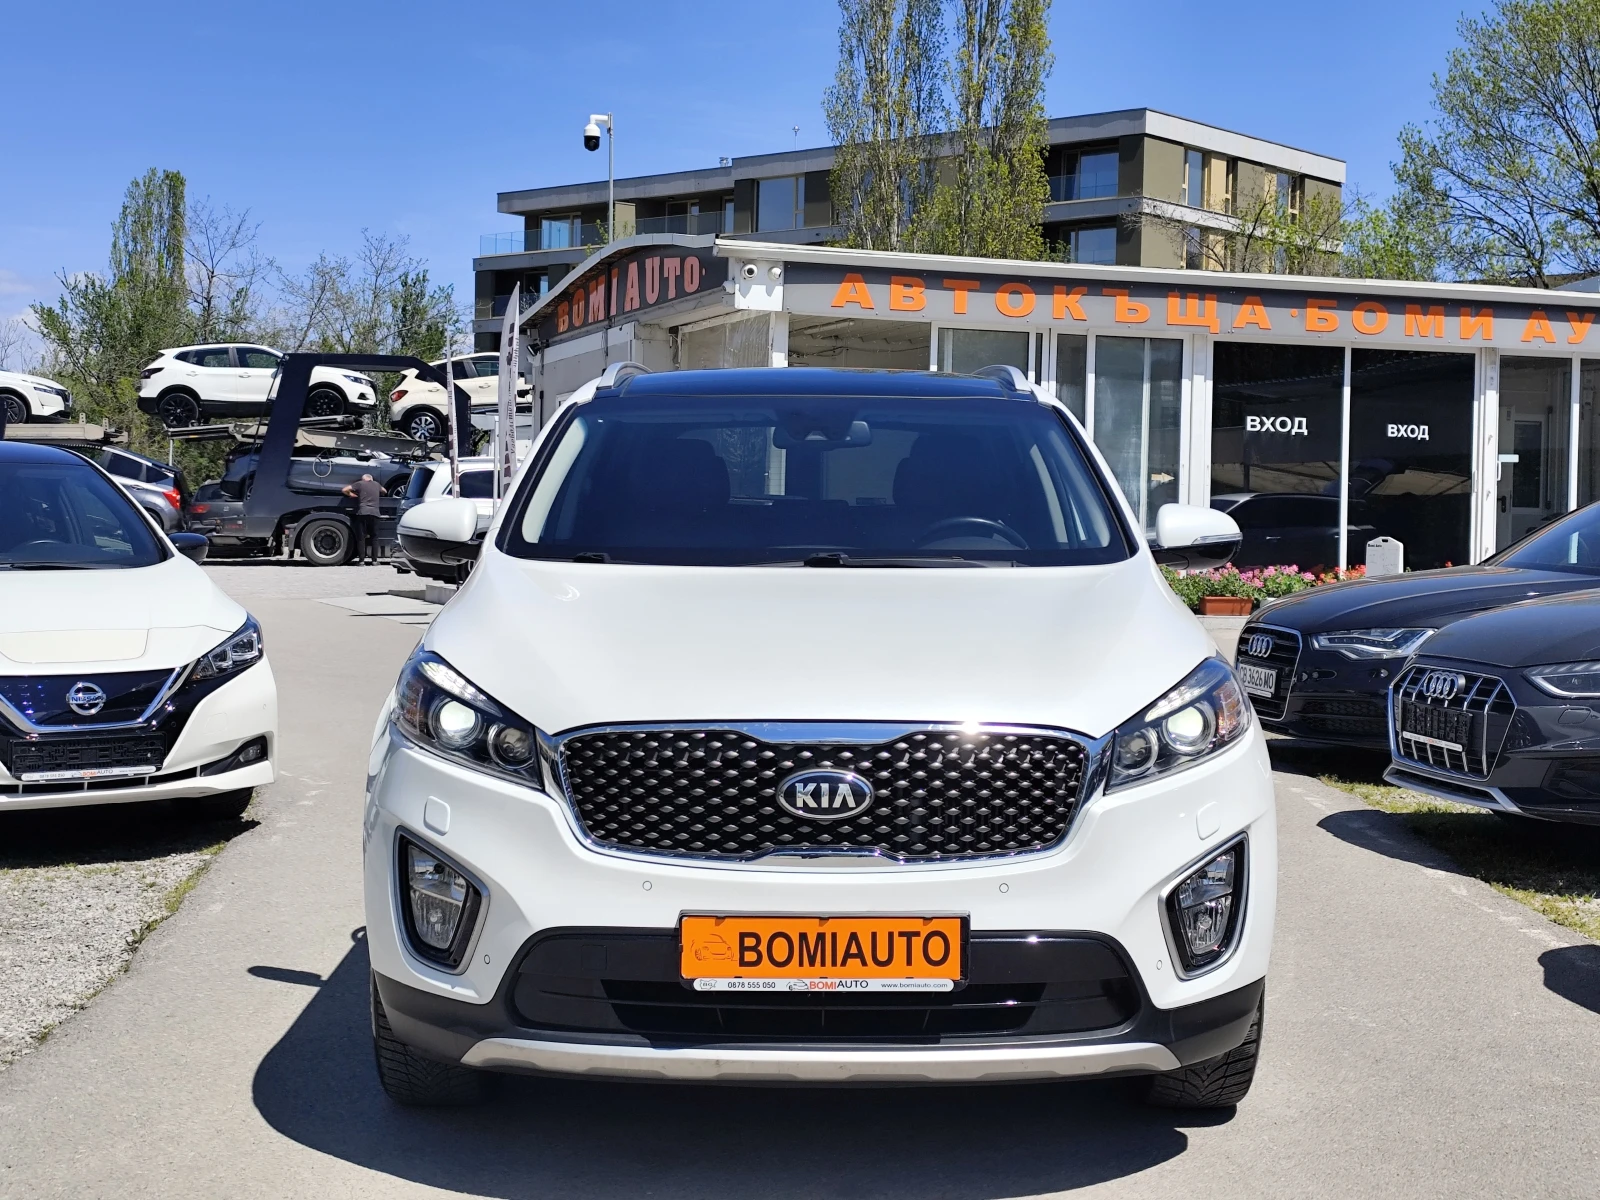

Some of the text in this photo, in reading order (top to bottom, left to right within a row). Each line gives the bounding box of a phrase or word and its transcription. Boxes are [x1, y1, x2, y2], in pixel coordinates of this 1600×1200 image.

[831, 273, 1596, 344] АВТОКЪЩА БОМИ АУ
[1246, 416, 1308, 435] ВХОД
[1386, 424, 1429, 440] ВХОД
[1247, 668, 1263, 687] 3626
[1263, 671, 1274, 690] MO
[795, 783, 857, 808] KIA
[739, 930, 950, 967] BOMIAUTO
[727, 981, 776, 989] 0878 555 050
